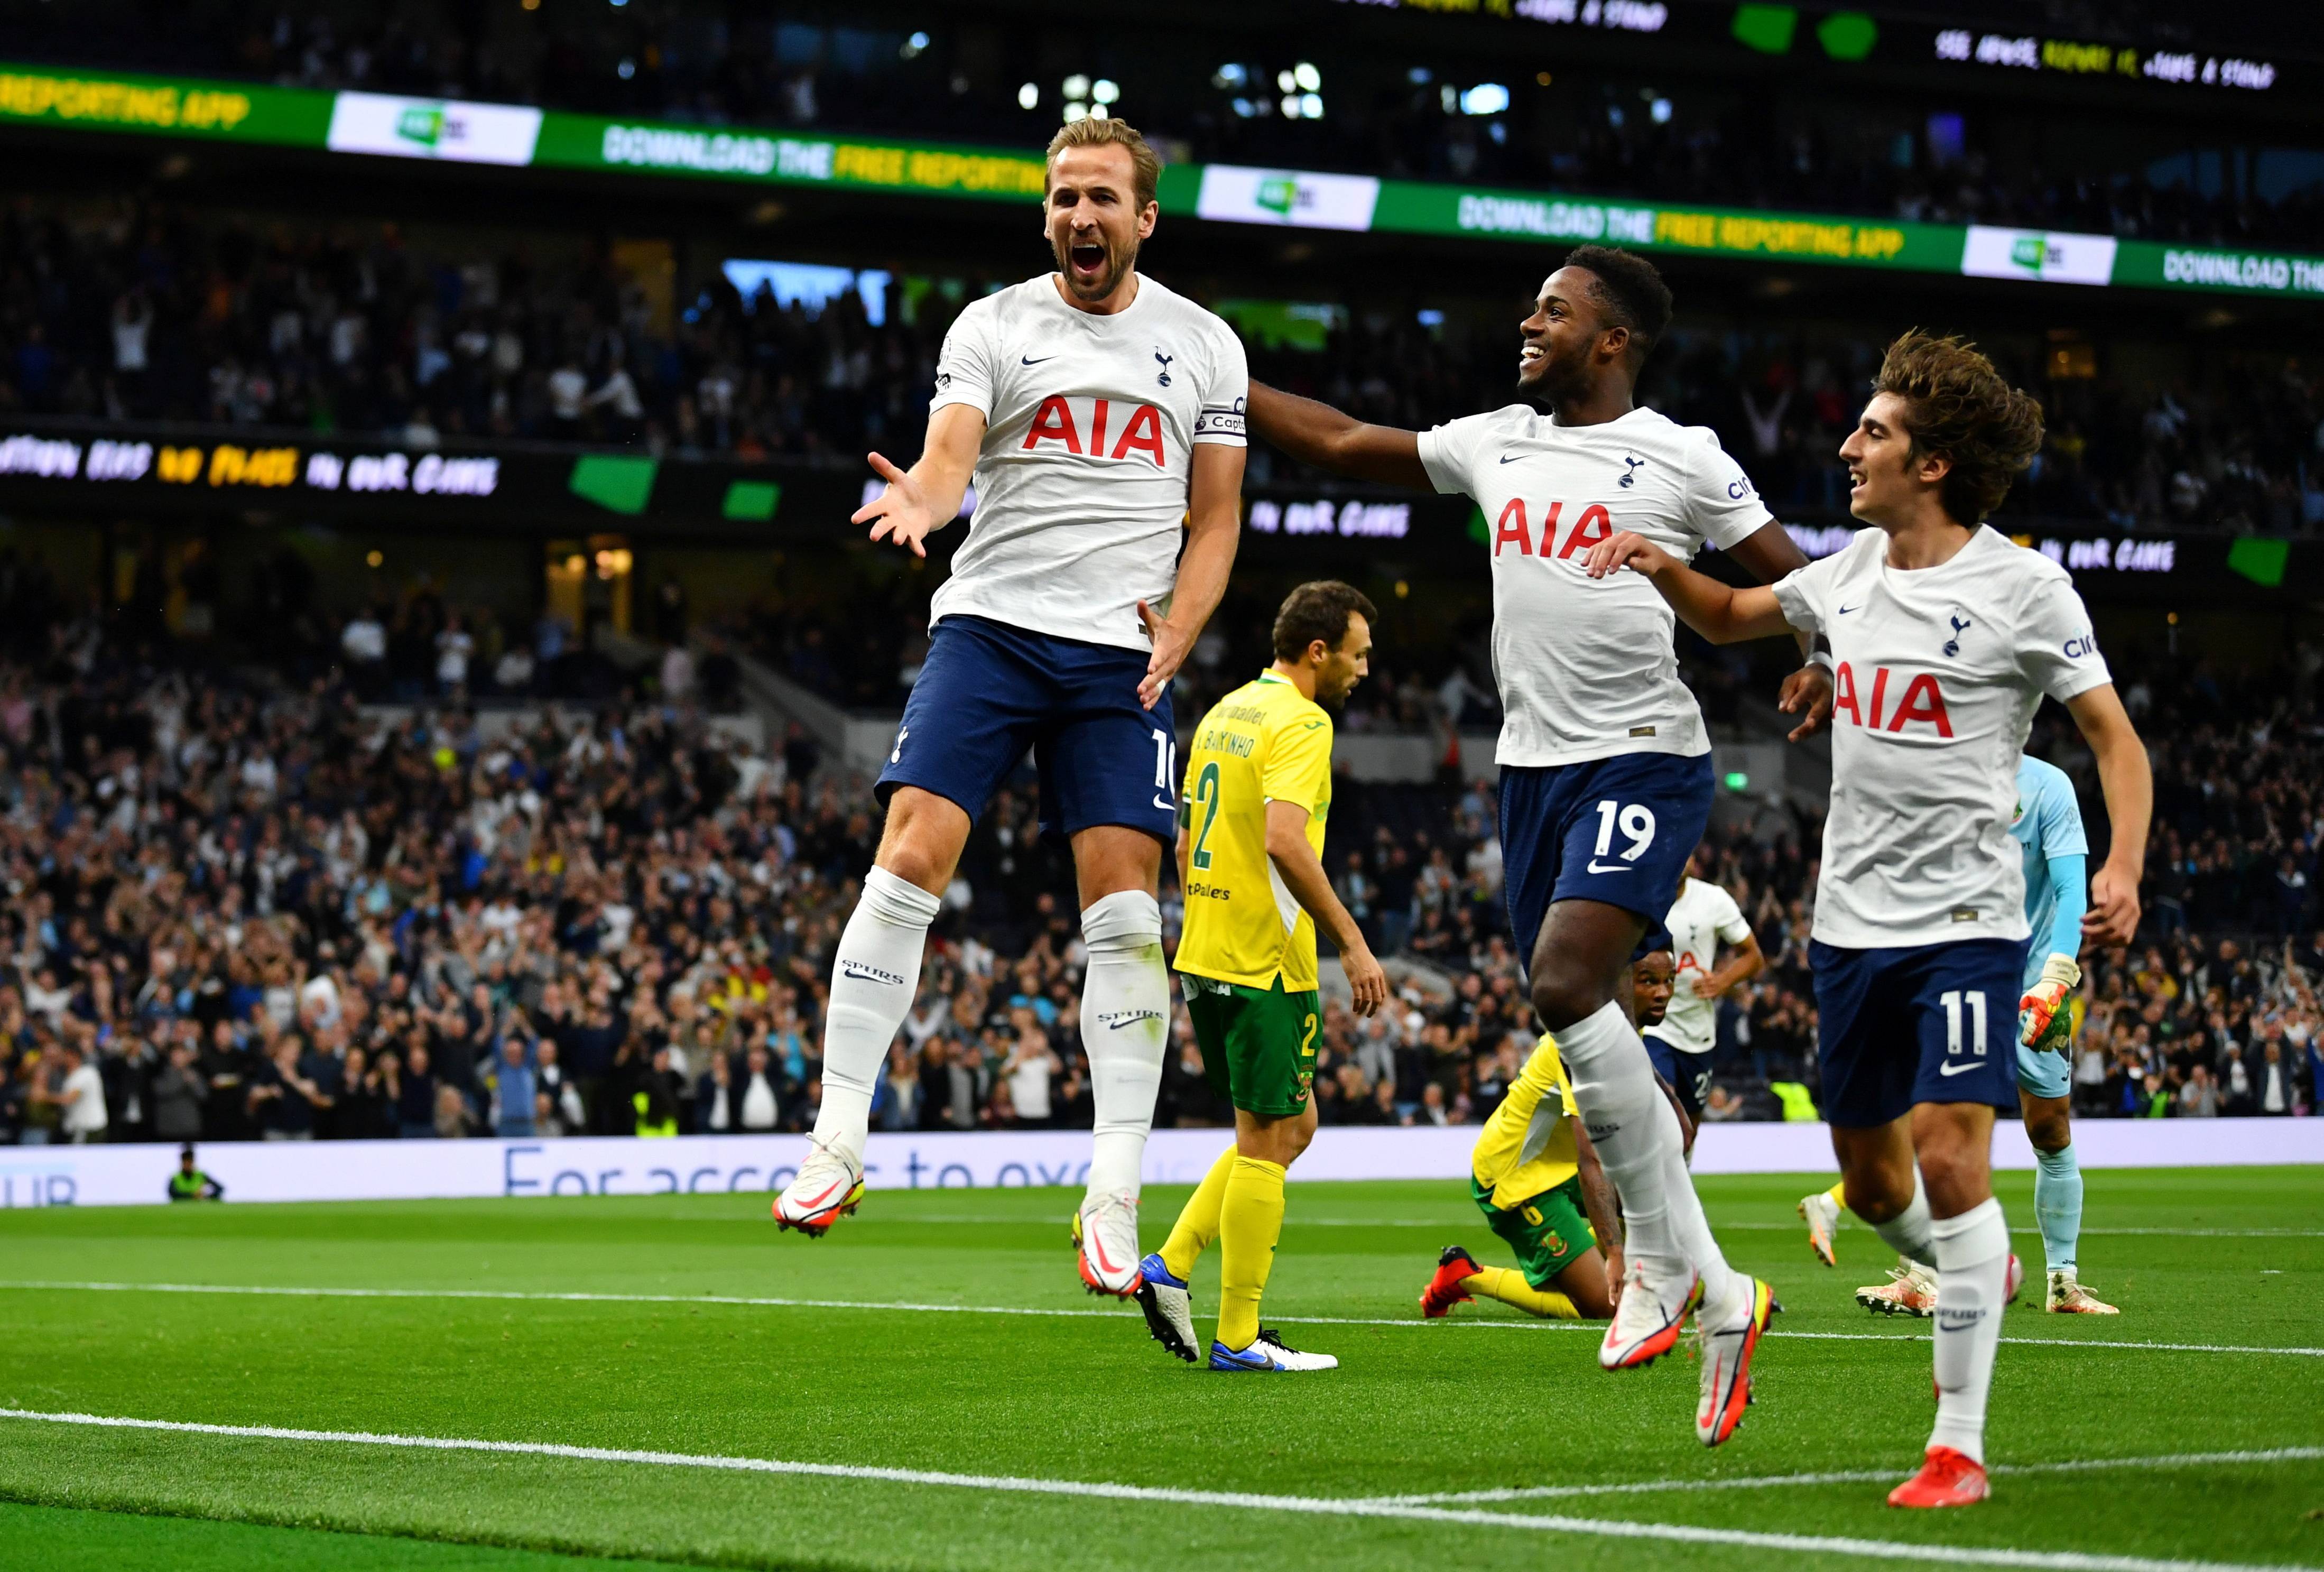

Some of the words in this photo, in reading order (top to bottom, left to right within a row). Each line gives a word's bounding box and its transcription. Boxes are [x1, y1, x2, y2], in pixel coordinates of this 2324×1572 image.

[181, 90, 251, 131] APP
[602, 125, 774, 174] DOWNLOAD
[776, 138, 834, 180] THE
[834, 144, 904, 185] FREE
[1457, 194, 1605, 239] DOWNLOAD
[1607, 207, 1653, 244] THE
[1655, 212, 1715, 247] FREE
[1720, 216, 1851, 258] REPORTING
[1856, 227, 1903, 260] APP
[2164, 249, 2289, 290] DOWNLOAD
[1022, 394, 1164, 467] AIA
[1495, 497, 1613, 559] AIA
[2068, 537, 2111, 570] OUR
[2115, 538, 2175, 573] GAME
[1832, 661, 1954, 738] AIA
[1193, 761, 1220, 871] 2
[1594, 800, 1655, 862] 19
[841, 959, 904, 984] SPURS
[1098, 1010, 1163, 1022] SPURS
[1302, 1013, 1317, 1057] 2
[1940, 990, 1987, 1056] 11
